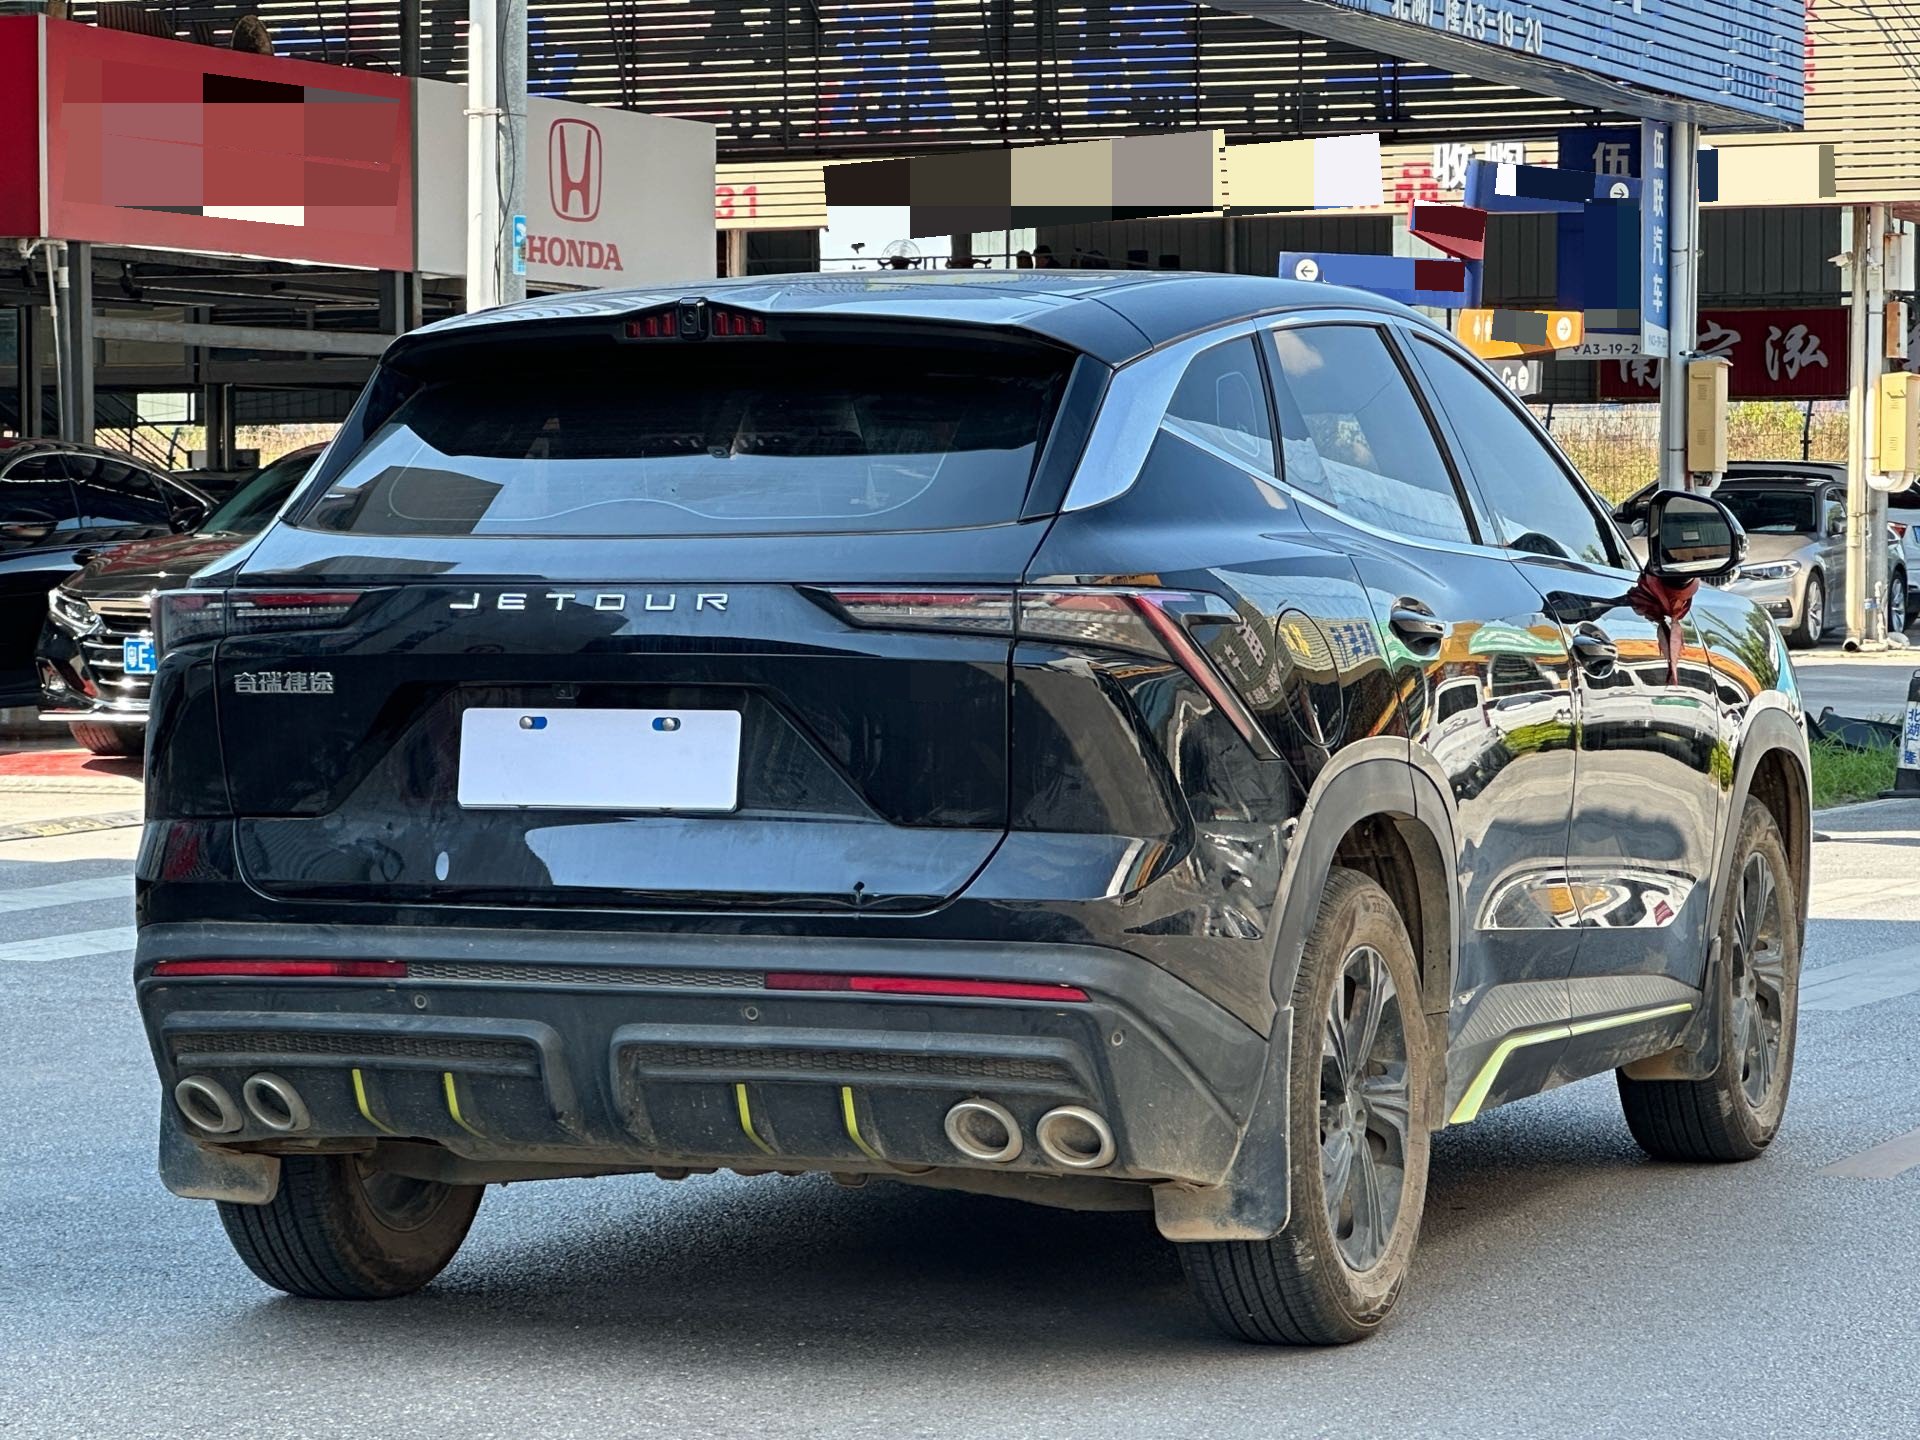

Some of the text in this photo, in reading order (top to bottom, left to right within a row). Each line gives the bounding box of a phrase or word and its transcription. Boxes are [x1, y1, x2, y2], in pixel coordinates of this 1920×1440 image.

[1652, 129, 1664, 313] 伍联汽车
[526, 235, 624, 271] HONDA
[1583, 343, 1641, 355] A3-19-2
[449, 592, 729, 611] JETOUR
[234, 671, 334, 694] 奇瑞捷途
